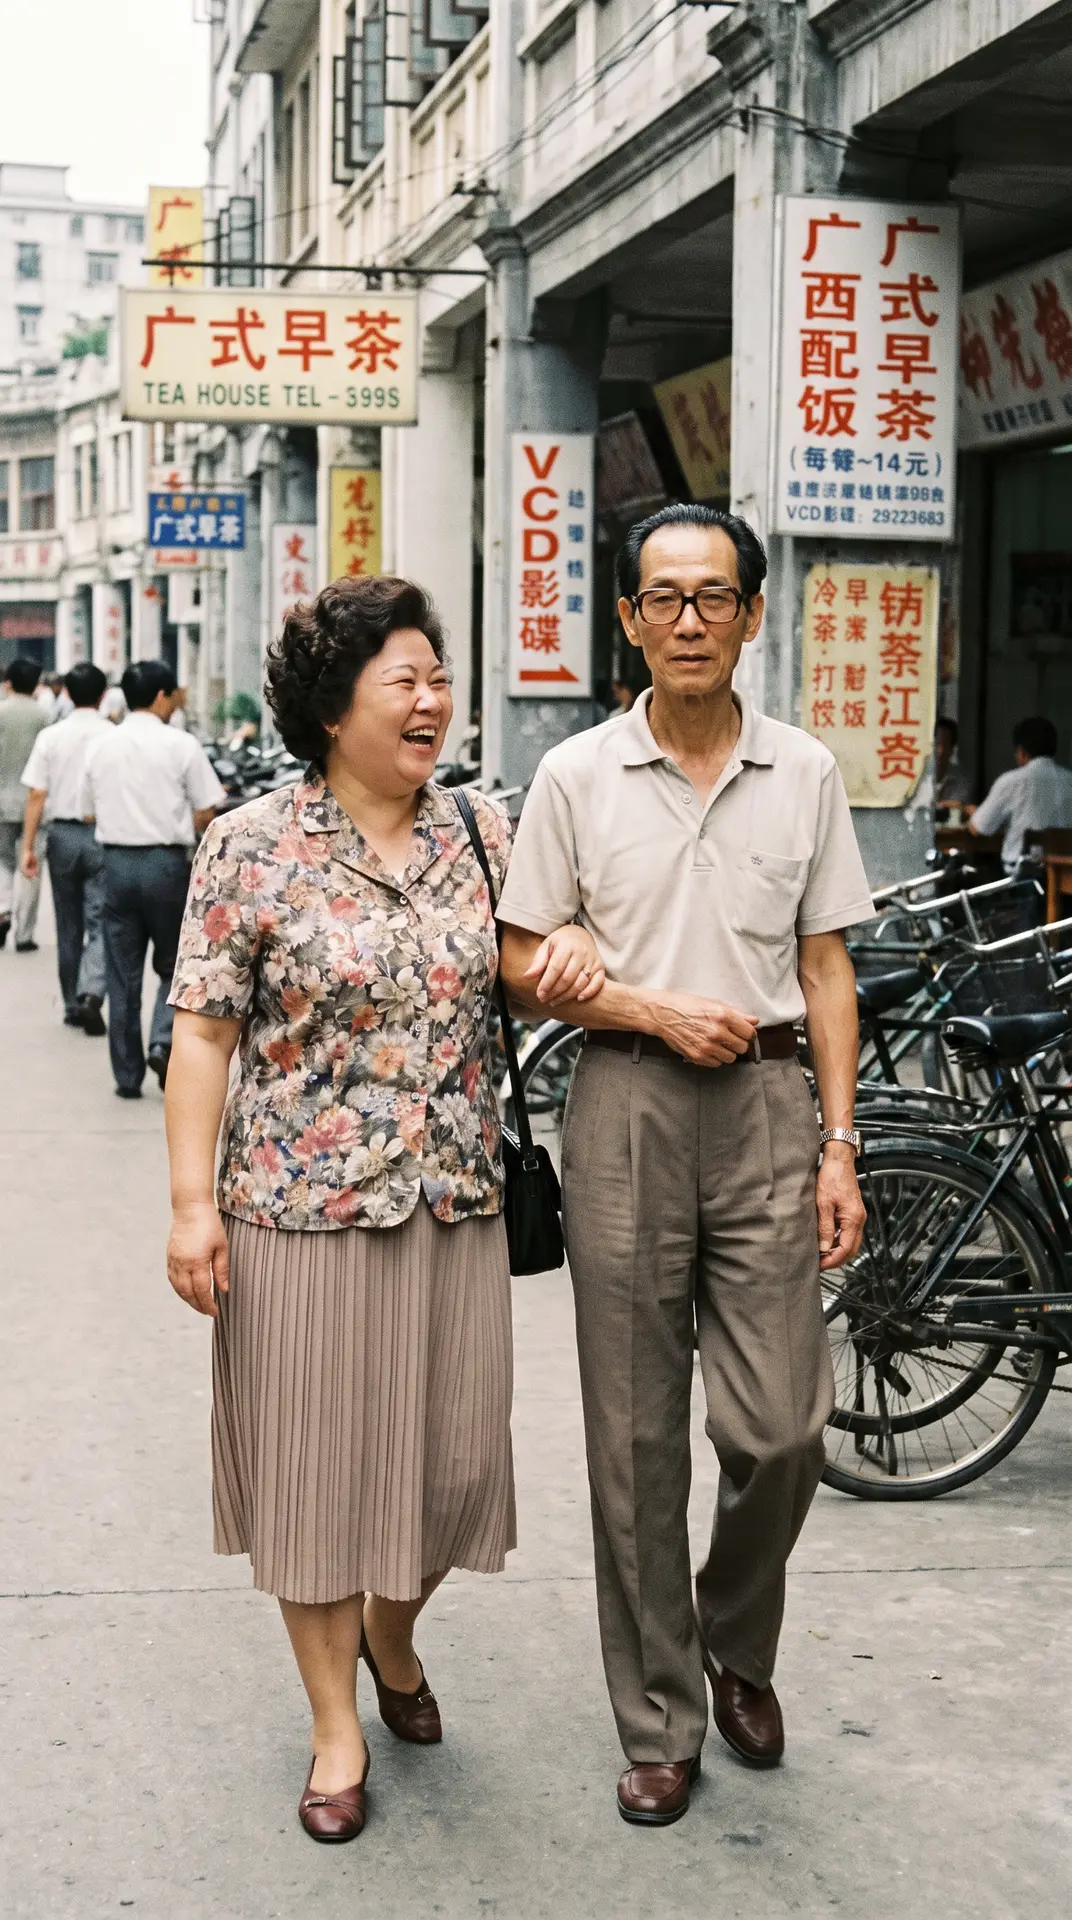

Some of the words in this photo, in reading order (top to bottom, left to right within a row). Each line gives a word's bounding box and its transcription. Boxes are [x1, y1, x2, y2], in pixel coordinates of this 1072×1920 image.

[139, 306, 402, 374] 广式早茶
[797, 212, 862, 438] 广西配饭
[875, 216, 941, 442] 广式早茶
[144, 383, 185, 405] TEA
[197, 383, 270, 407] HOUSE
[872, 508, 945, 526] 29223683
